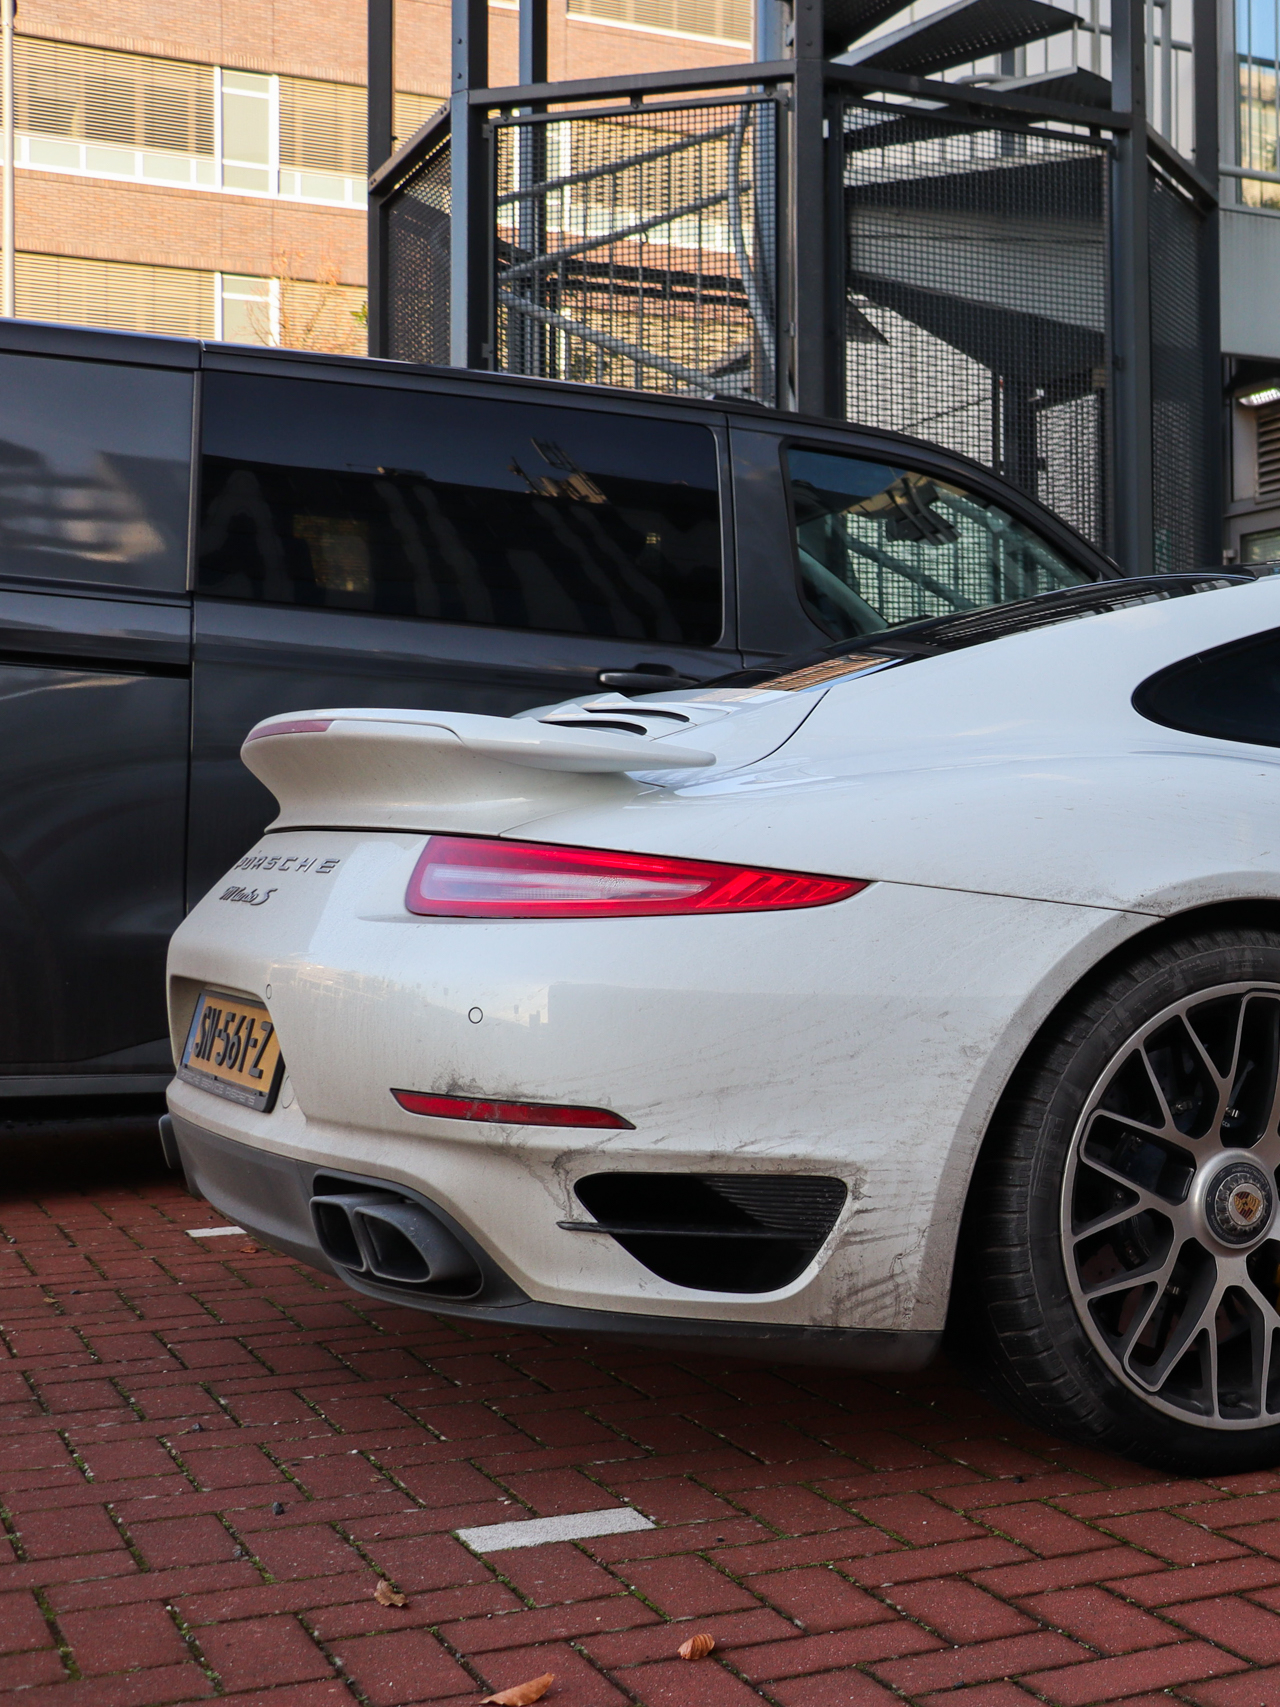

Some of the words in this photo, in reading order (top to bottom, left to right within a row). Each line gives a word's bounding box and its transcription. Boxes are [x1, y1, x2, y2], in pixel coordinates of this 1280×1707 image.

[234, 856, 341, 874] PORSCHE
[250, 888, 278, 906] S
[193, 1005, 275, 1080] SN-561-Z
